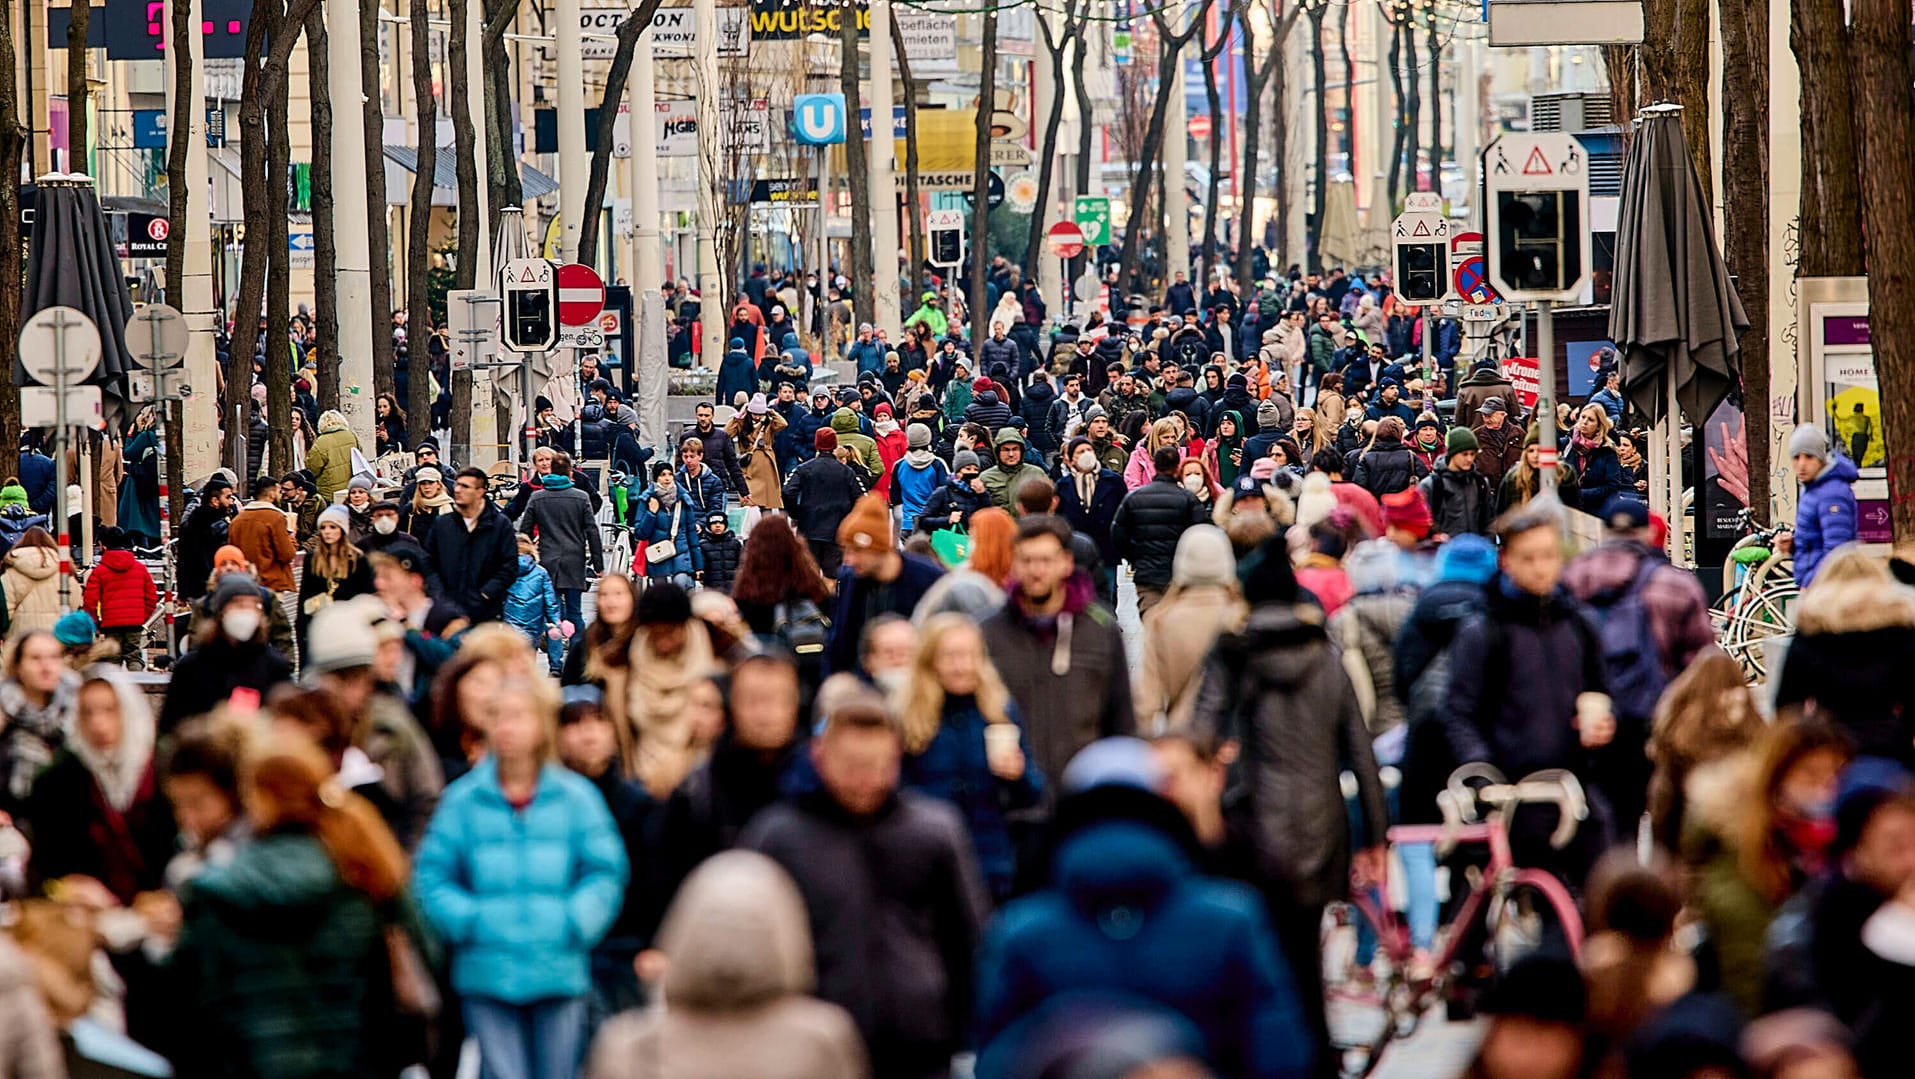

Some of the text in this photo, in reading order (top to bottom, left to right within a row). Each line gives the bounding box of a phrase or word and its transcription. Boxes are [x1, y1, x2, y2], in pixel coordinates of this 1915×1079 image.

[751, 7, 870, 32] wutsc
[803, 105, 835, 139] U
[919, 174, 972, 187] TASCHE
[130, 242, 156, 251] ROYAL
[1839, 368, 1870, 376] HOME
